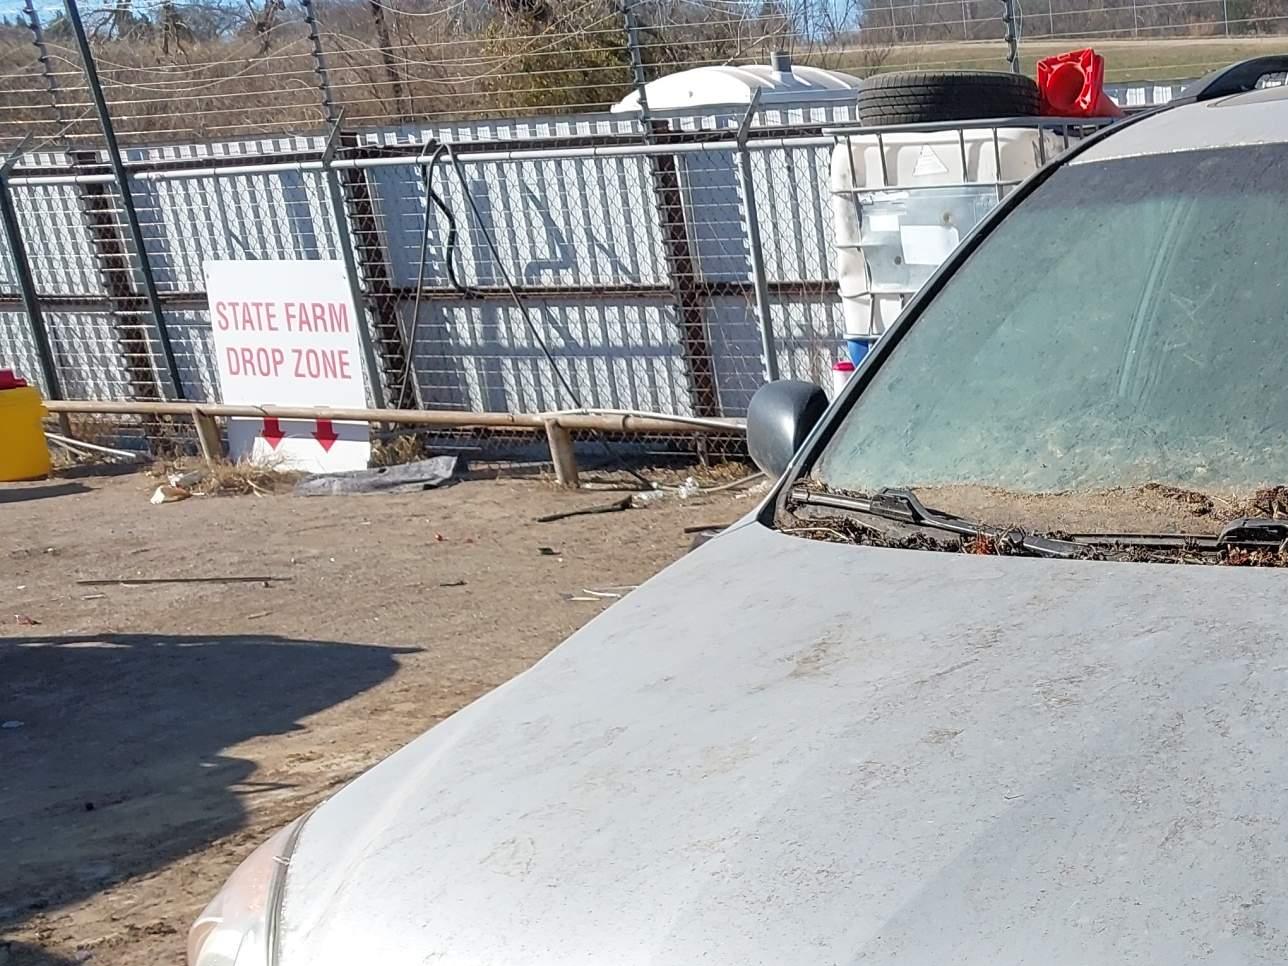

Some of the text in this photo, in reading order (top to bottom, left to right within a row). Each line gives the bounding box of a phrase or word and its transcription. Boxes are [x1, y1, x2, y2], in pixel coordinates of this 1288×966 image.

[216, 301, 350, 333] STATE FARM
[226, 347, 352, 379] DROP ZONE
